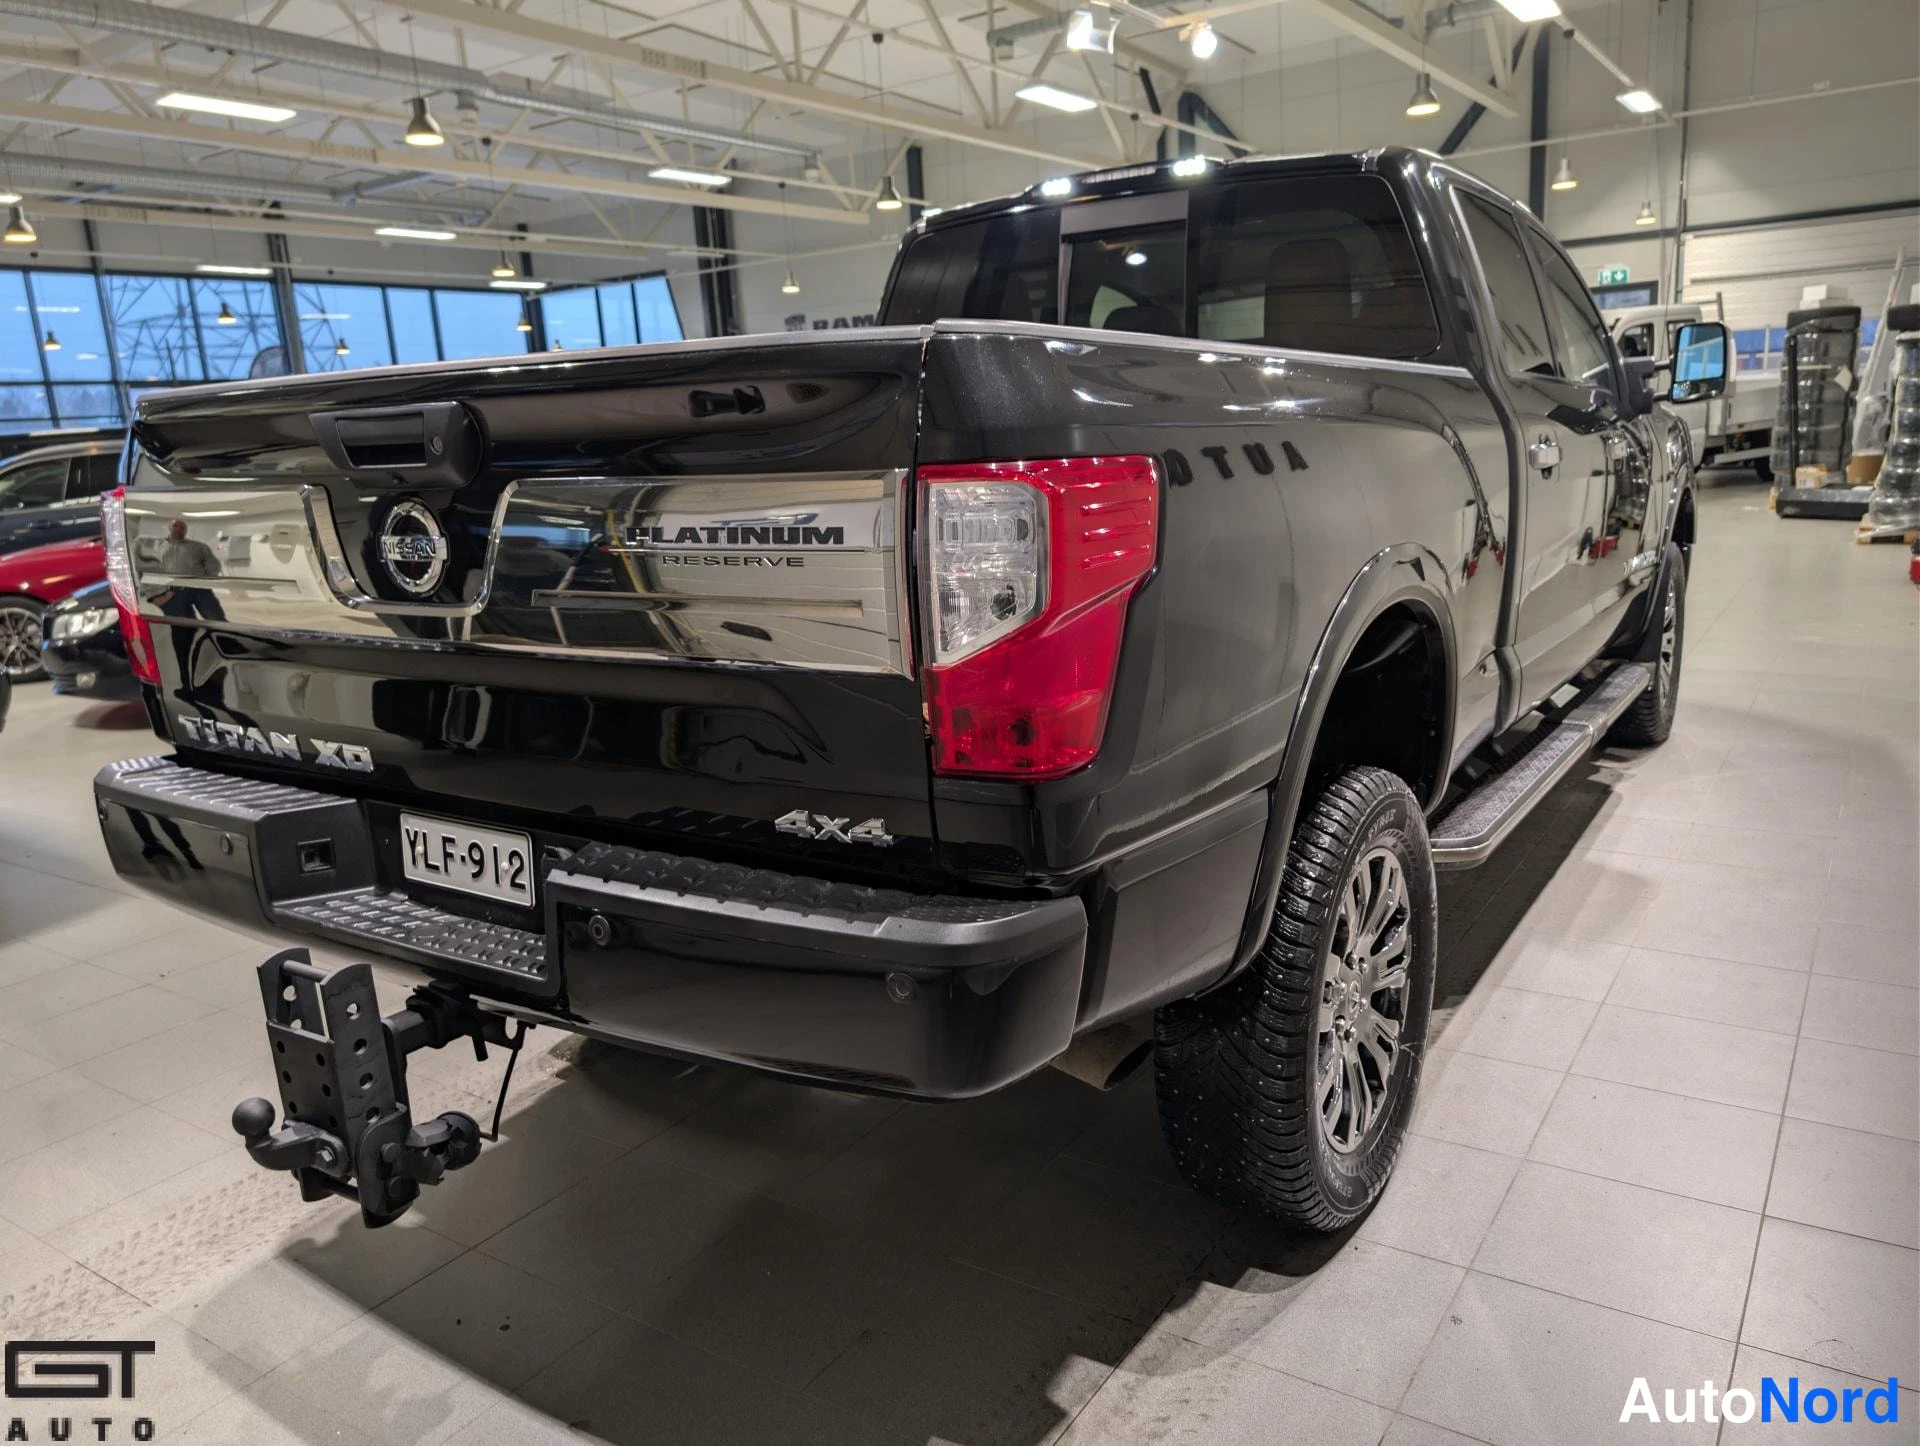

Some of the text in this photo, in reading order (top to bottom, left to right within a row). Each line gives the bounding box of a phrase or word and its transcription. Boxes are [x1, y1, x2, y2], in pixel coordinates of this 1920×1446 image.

[626, 526, 844, 545] PLATINUM
[383, 541, 437, 557] NISSAN
[662, 555, 805, 568] RESERVE
[178, 714, 374, 773] TITAN XD
[403, 826, 528, 891] YLF-912
